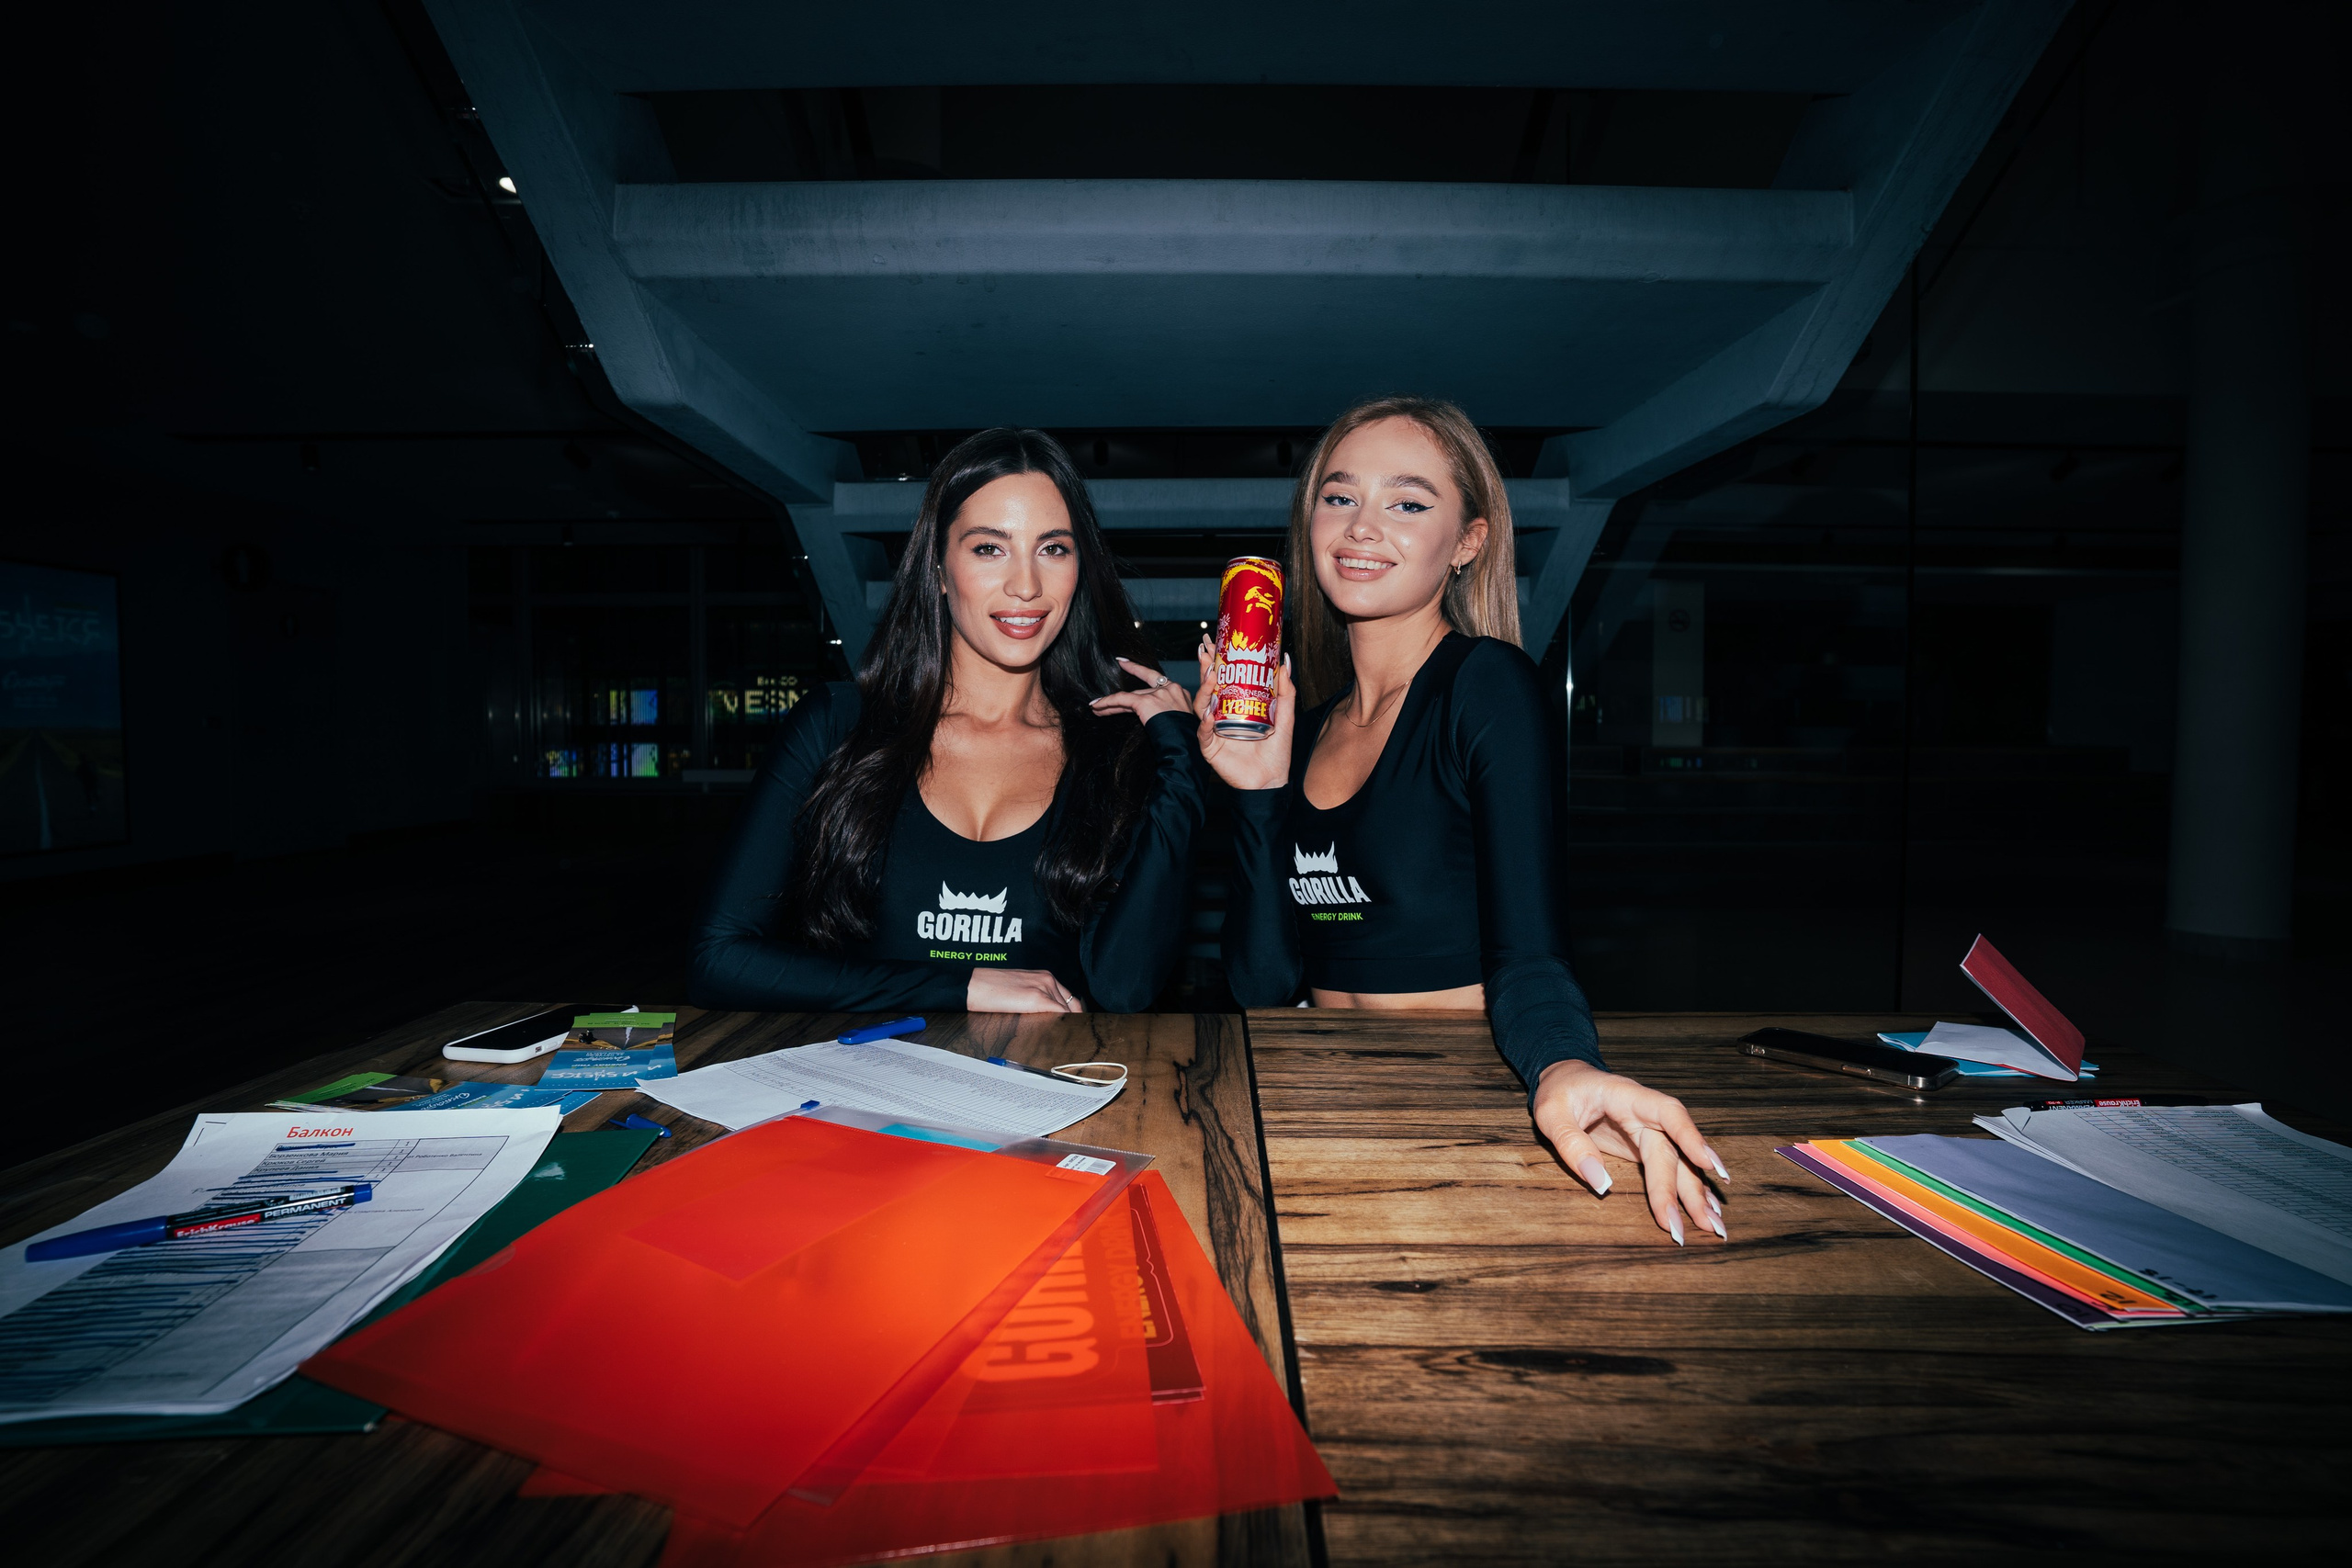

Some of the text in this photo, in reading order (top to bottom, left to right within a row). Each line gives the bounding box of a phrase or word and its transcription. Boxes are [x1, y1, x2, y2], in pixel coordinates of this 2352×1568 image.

[1217, 663, 1274, 689] GORILLA
[1245, 689, 1271, 699] ENERGY
[1222, 699, 1267, 717] LYCHEE
[1288, 875, 1373, 905] GORILLA
[1311, 912, 1363, 921] ENERGY DRINK
[917, 910, 1023, 943] GORILLA
[930, 950, 1008, 962] ENERGY DRINK
[2098, 1099, 2141, 1107] ErichKrause
[287, 1126, 354, 1138] Балкон
[295, 1157, 327, 1166] Сергей
[175, 1216, 257, 1238] ErichKrause
[265, 1197, 346, 1219] PERMANENT
[1107, 1263, 1158, 1339] ENERGY
[2099, 1290, 2137, 1304] 12
[2056, 1303, 2091, 1317] 10
